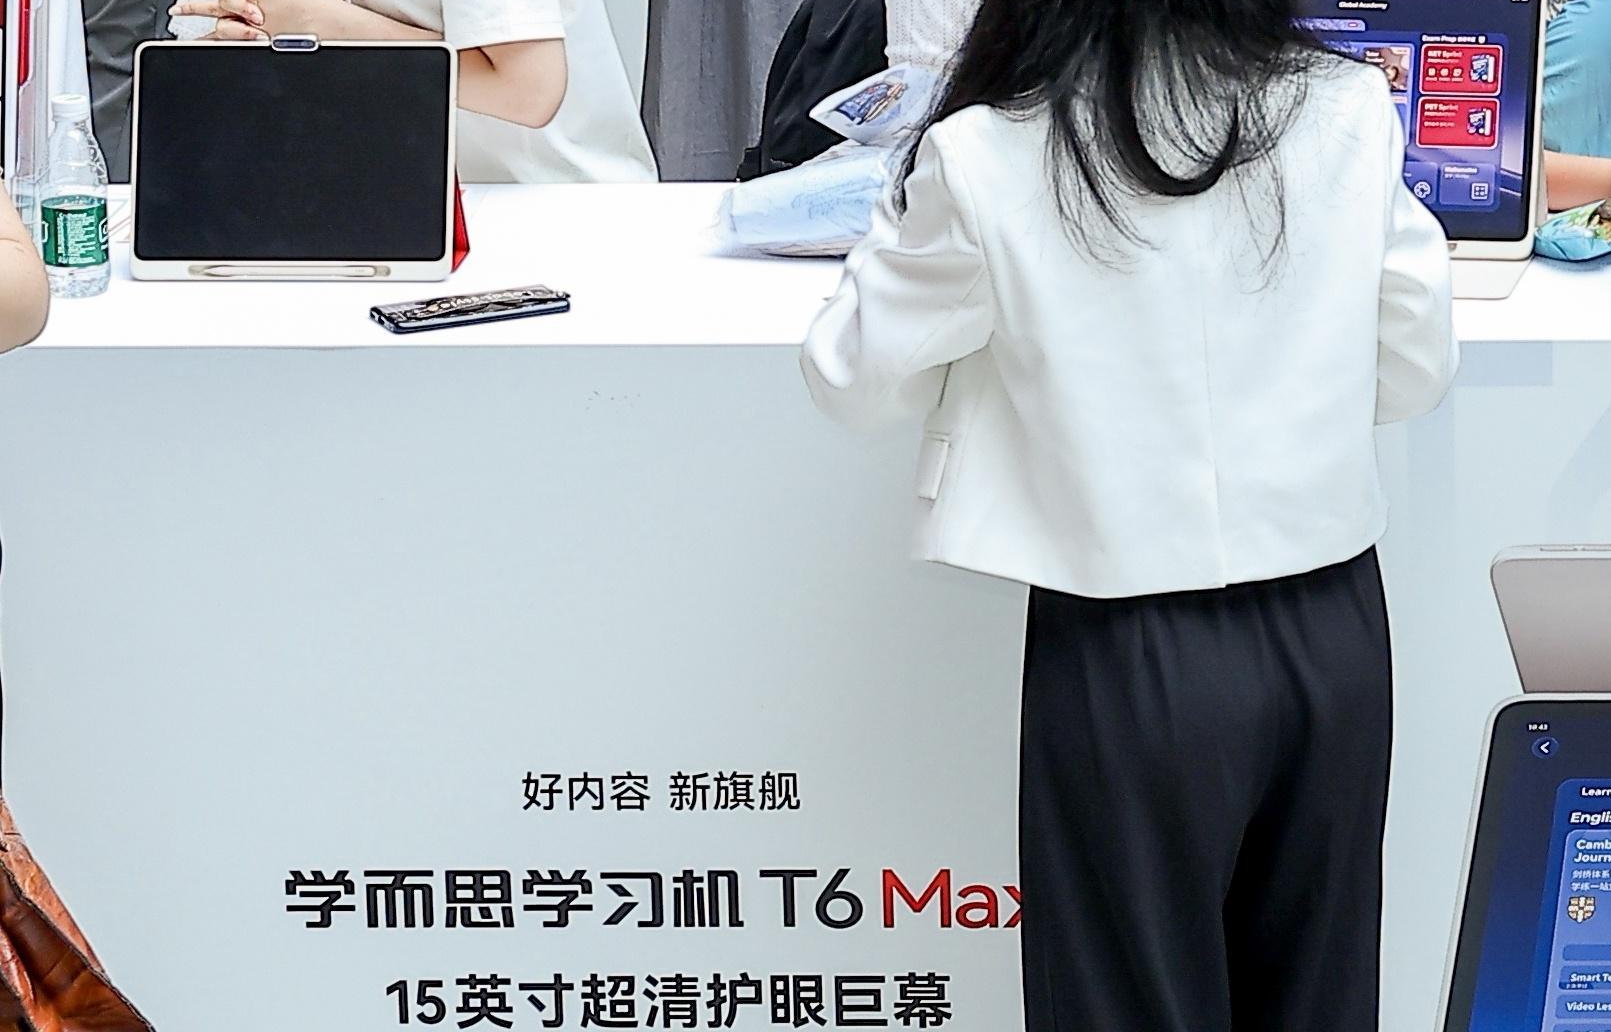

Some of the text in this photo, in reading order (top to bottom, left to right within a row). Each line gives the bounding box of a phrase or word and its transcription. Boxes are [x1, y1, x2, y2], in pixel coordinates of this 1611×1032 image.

[522, 771, 801, 811] 好内容 新旗舰
[285, 869, 744, 929] 学而思学习机
[758, 868, 864, 929] T6
[1570, 972, 1601, 982] Smart
[385, 972, 953, 1030] 15英寸超清护眼巨幕
[1566, 1001, 1595, 1011] Video
